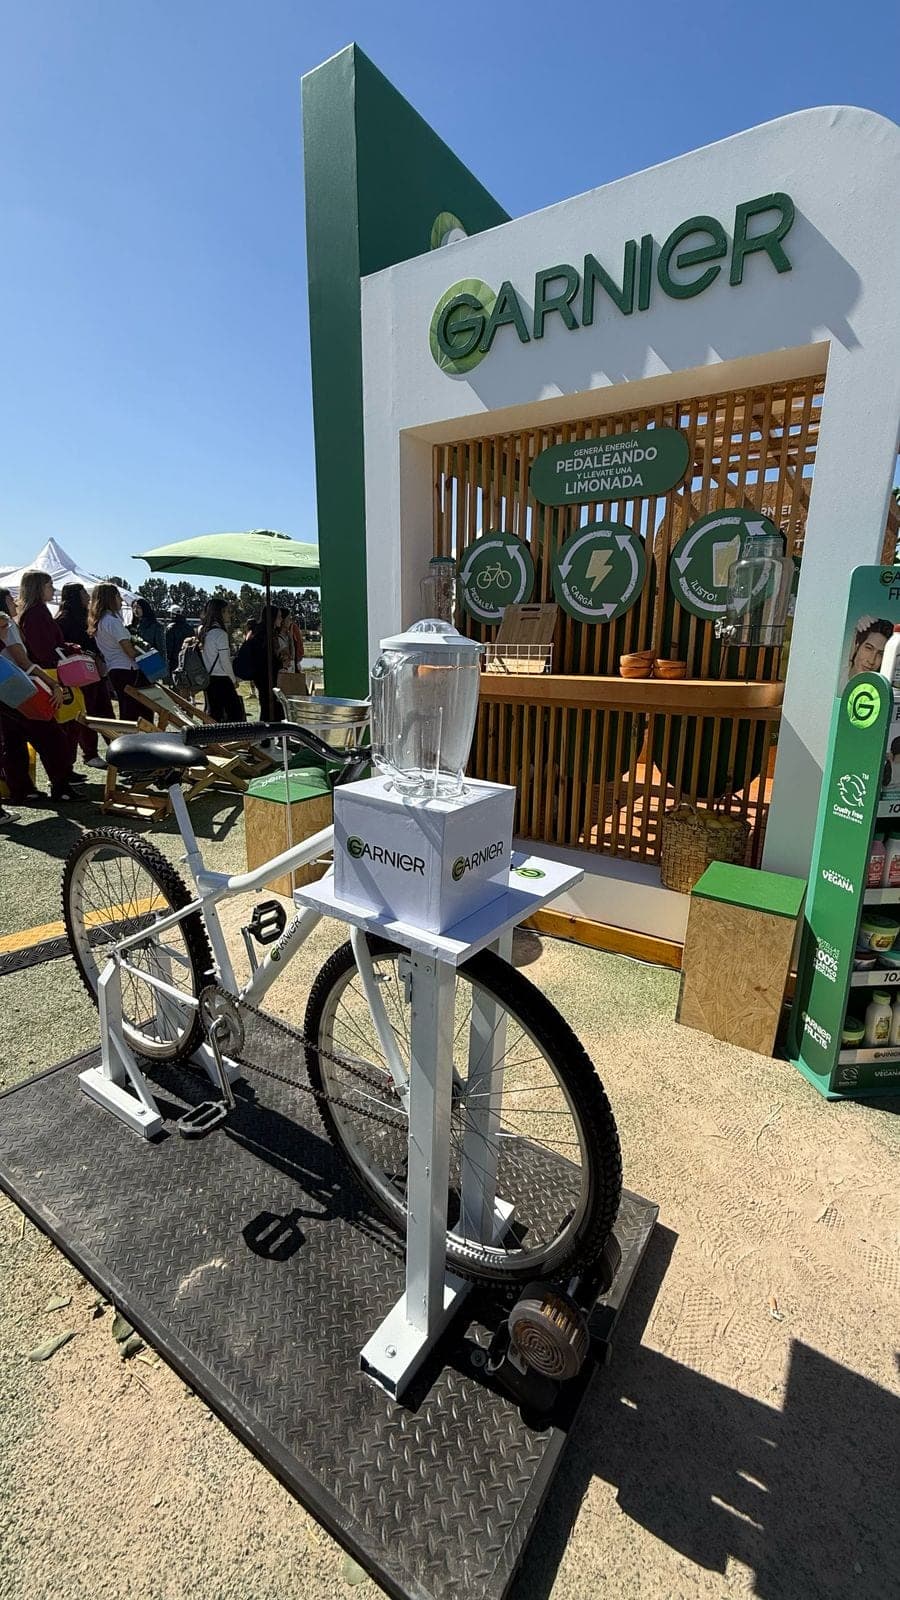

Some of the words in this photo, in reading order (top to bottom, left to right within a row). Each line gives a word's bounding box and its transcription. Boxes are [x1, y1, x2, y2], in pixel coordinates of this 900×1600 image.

[436, 191, 795, 360] GARNIER
[604, 440, 639, 453] ENERGÍA
[555, 446, 658, 474] PEDALEANDO
[576, 472, 583, 480] Y
[583, 468, 614, 479] LLEVATE
[615, 465, 632, 475] UNA
[564, 473, 644, 496] LIMONADA
[348, 837, 426, 876] GARNIER
[452, 840, 505, 881] GARNIER
[822, 869, 854, 894] VEGANA
